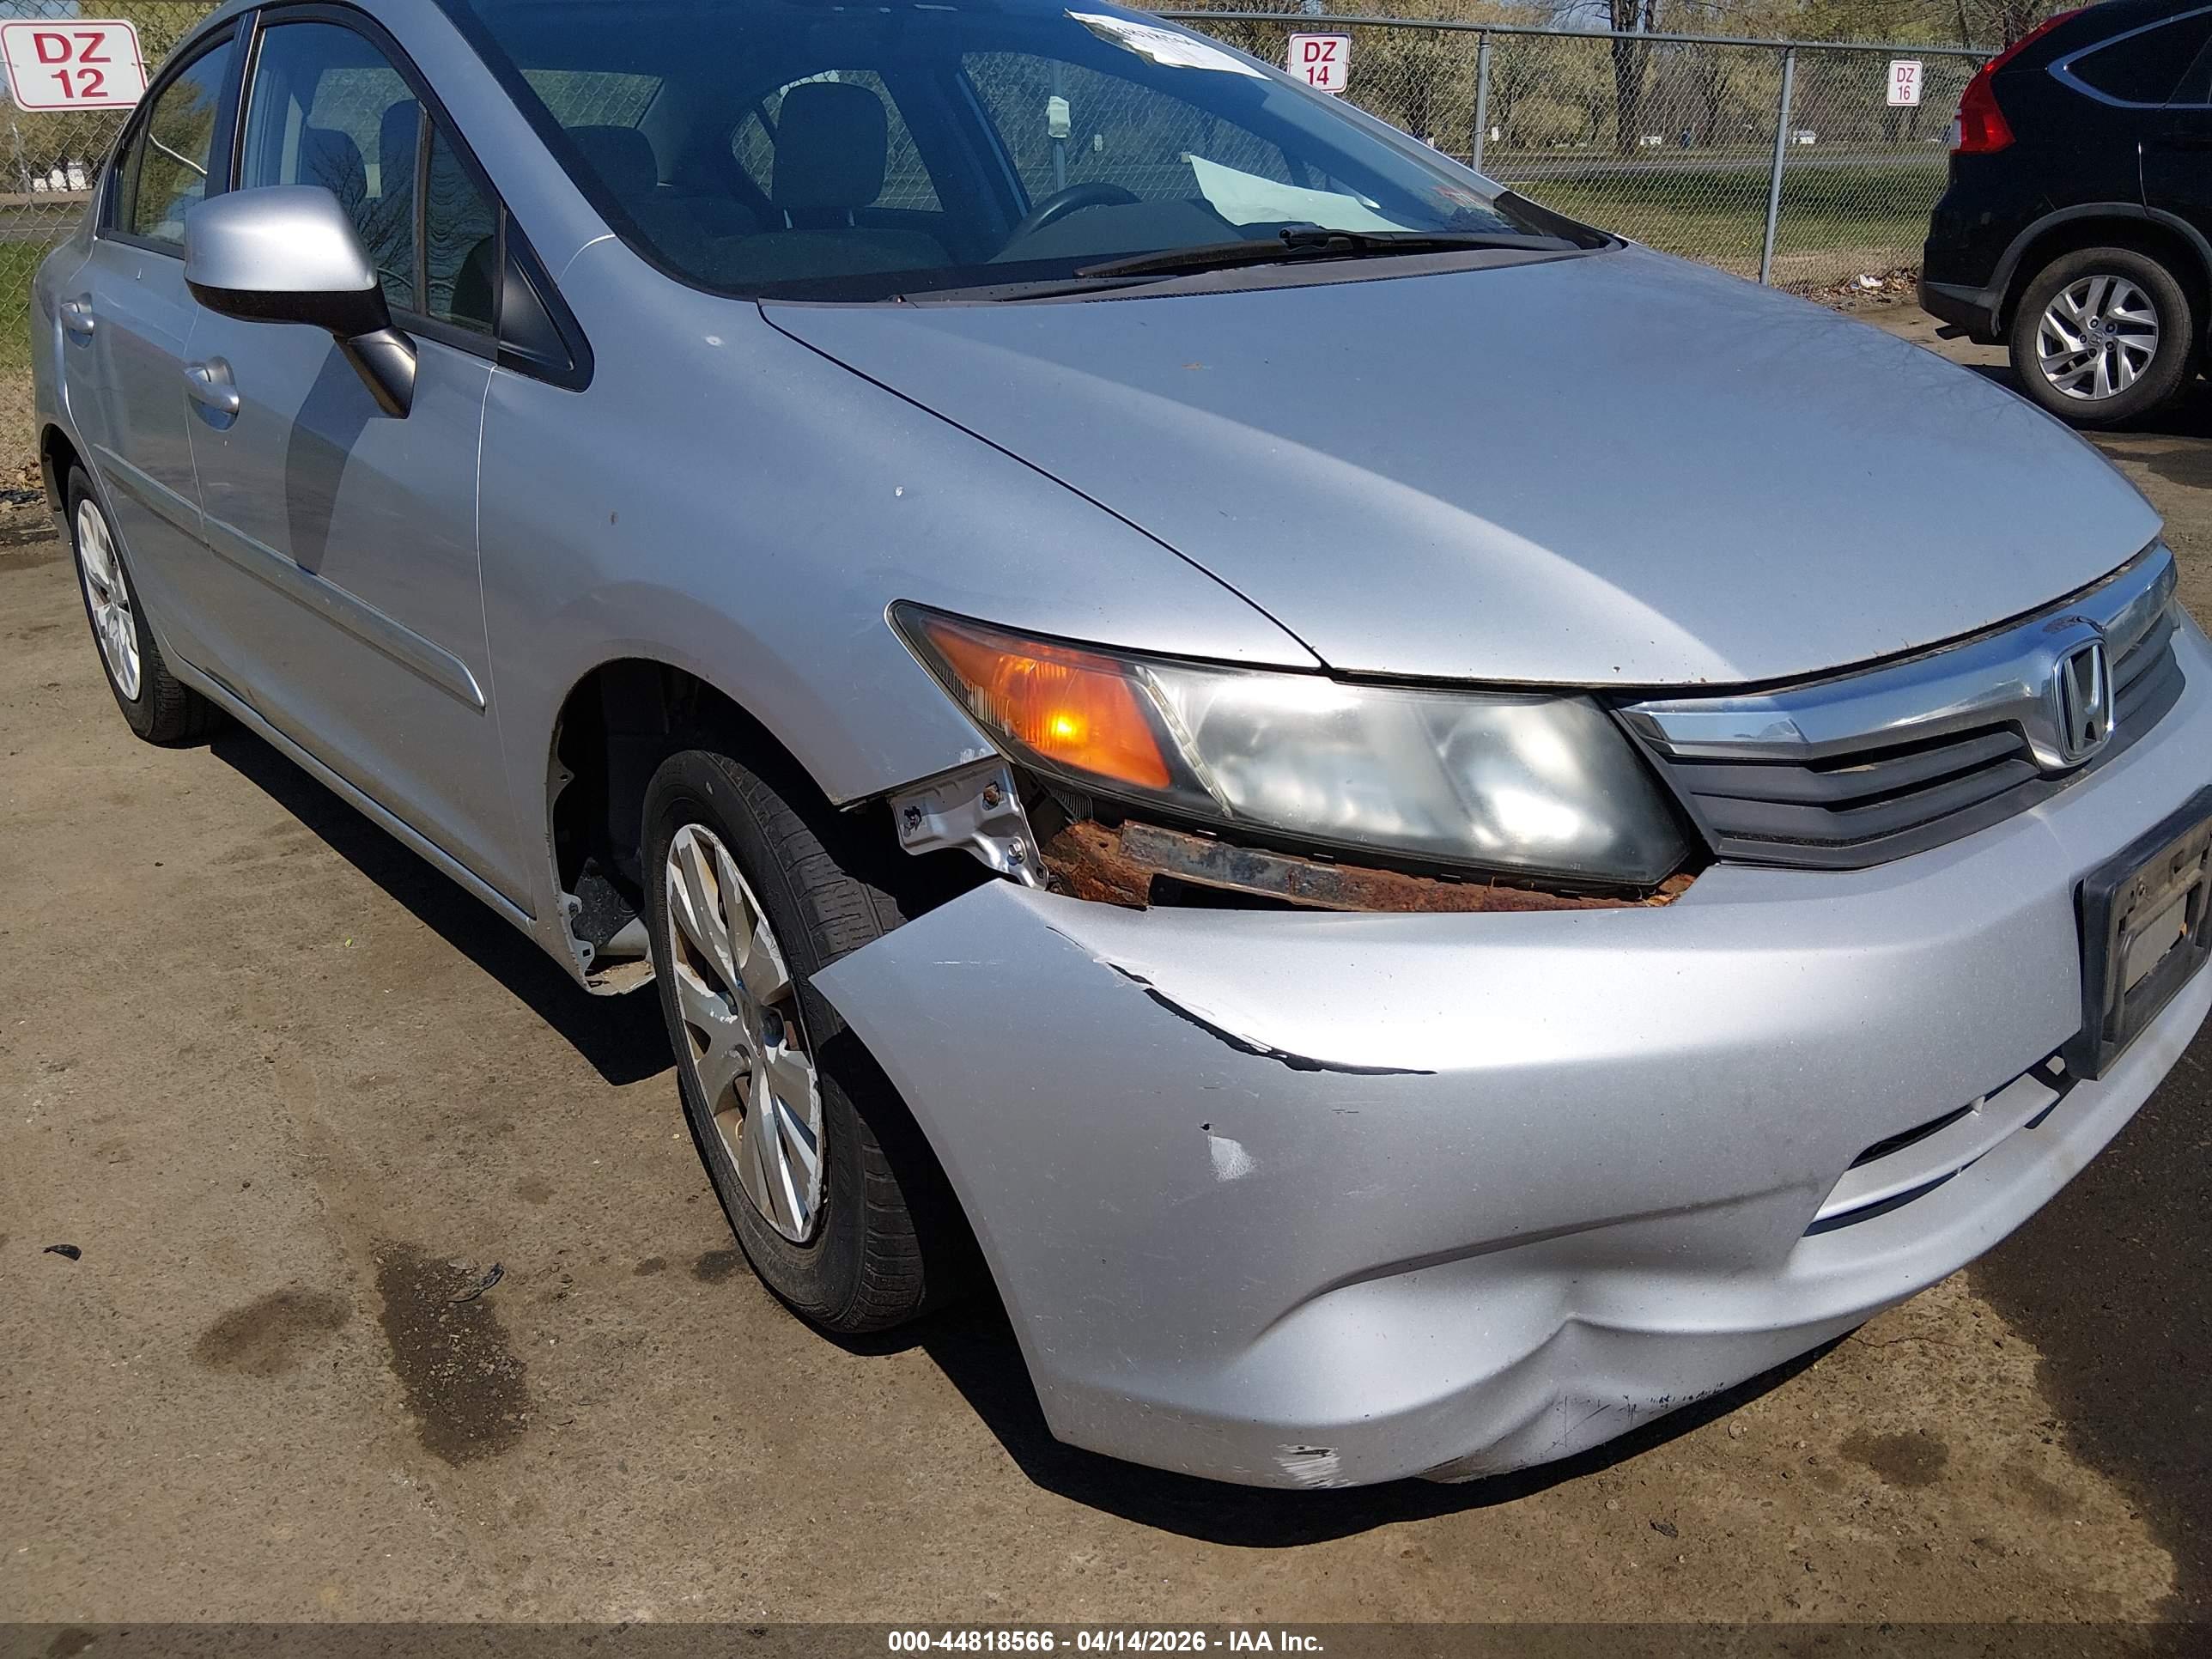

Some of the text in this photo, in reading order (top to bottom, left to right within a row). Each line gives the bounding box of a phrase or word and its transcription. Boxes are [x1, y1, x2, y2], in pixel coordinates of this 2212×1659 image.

[33, 32, 111, 64] DZ
[1304, 41, 1337, 63] DZ
[52, 69, 108, 99] 12
[1306, 65, 1329, 85] 14
[1897, 67, 1915, 82] DZ
[1899, 85, 1911, 100] 16
